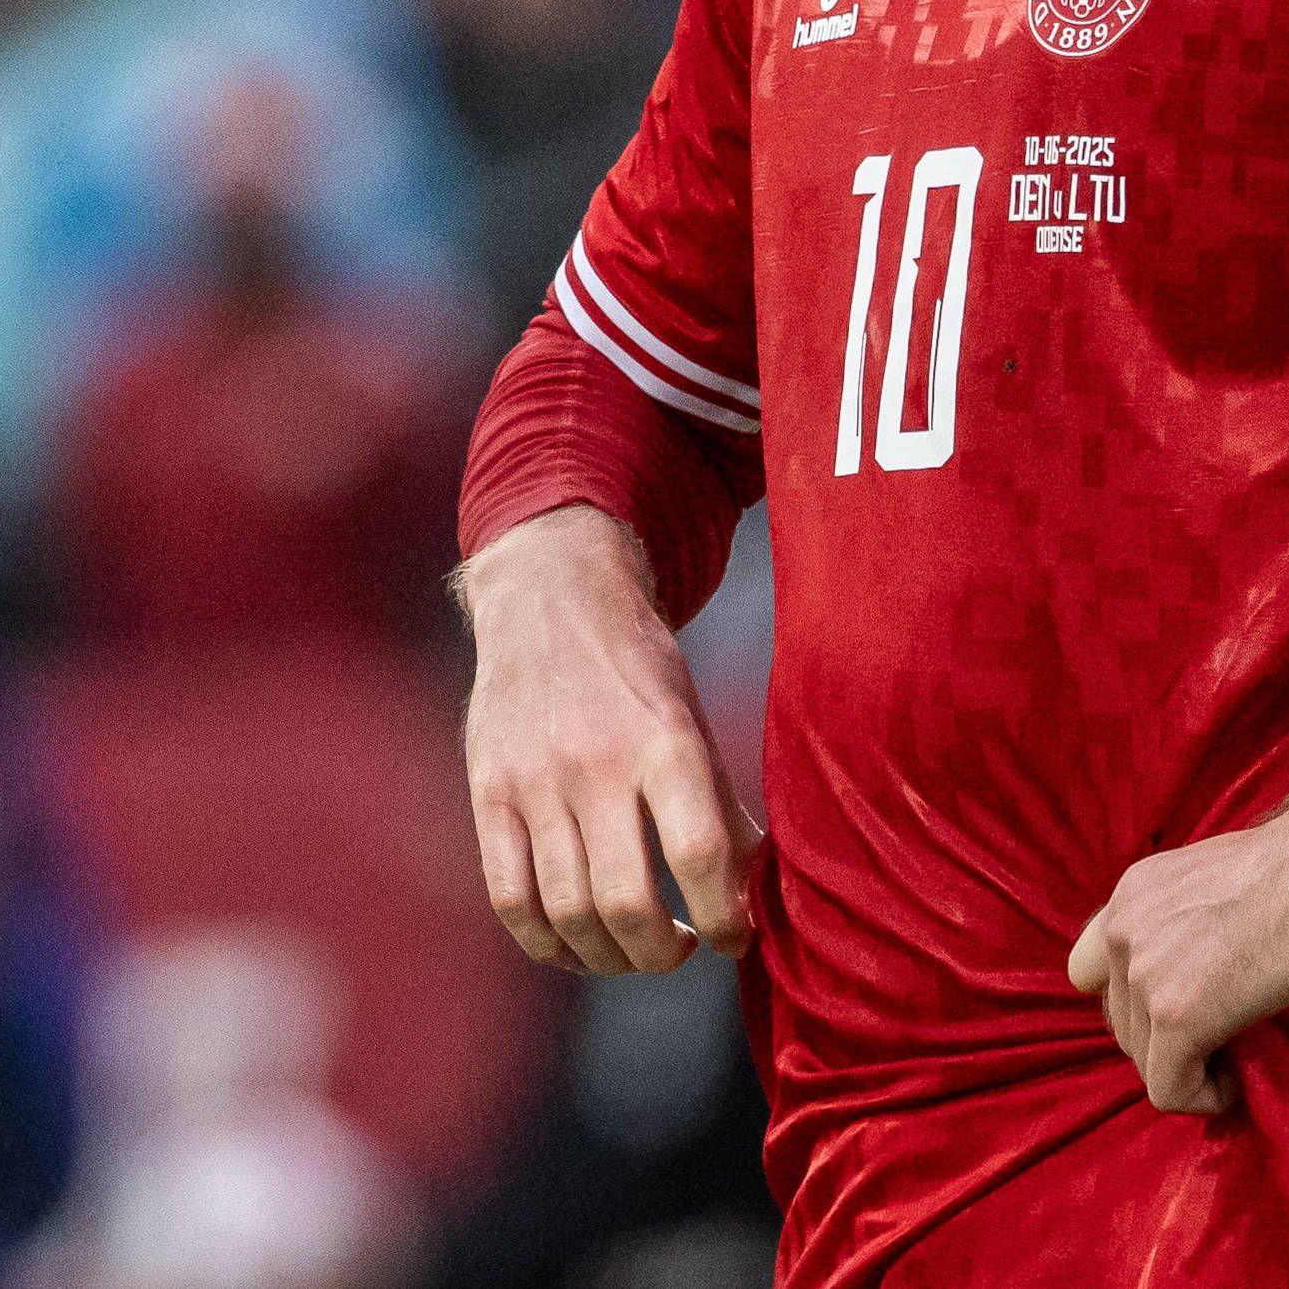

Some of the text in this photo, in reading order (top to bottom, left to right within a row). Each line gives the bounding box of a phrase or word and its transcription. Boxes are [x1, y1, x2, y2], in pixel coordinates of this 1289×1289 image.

[792, 3, 859, 49] hummel
[1046, 22, 1108, 49] 1889
[1025, 135, 1116, 167] 10-06-2025
[1008, 173, 1051, 221] DEN
[1068, 173, 1126, 223] LTU
[1036, 226, 1084, 253] ODENSE
[833, 144, 984, 476] 10
